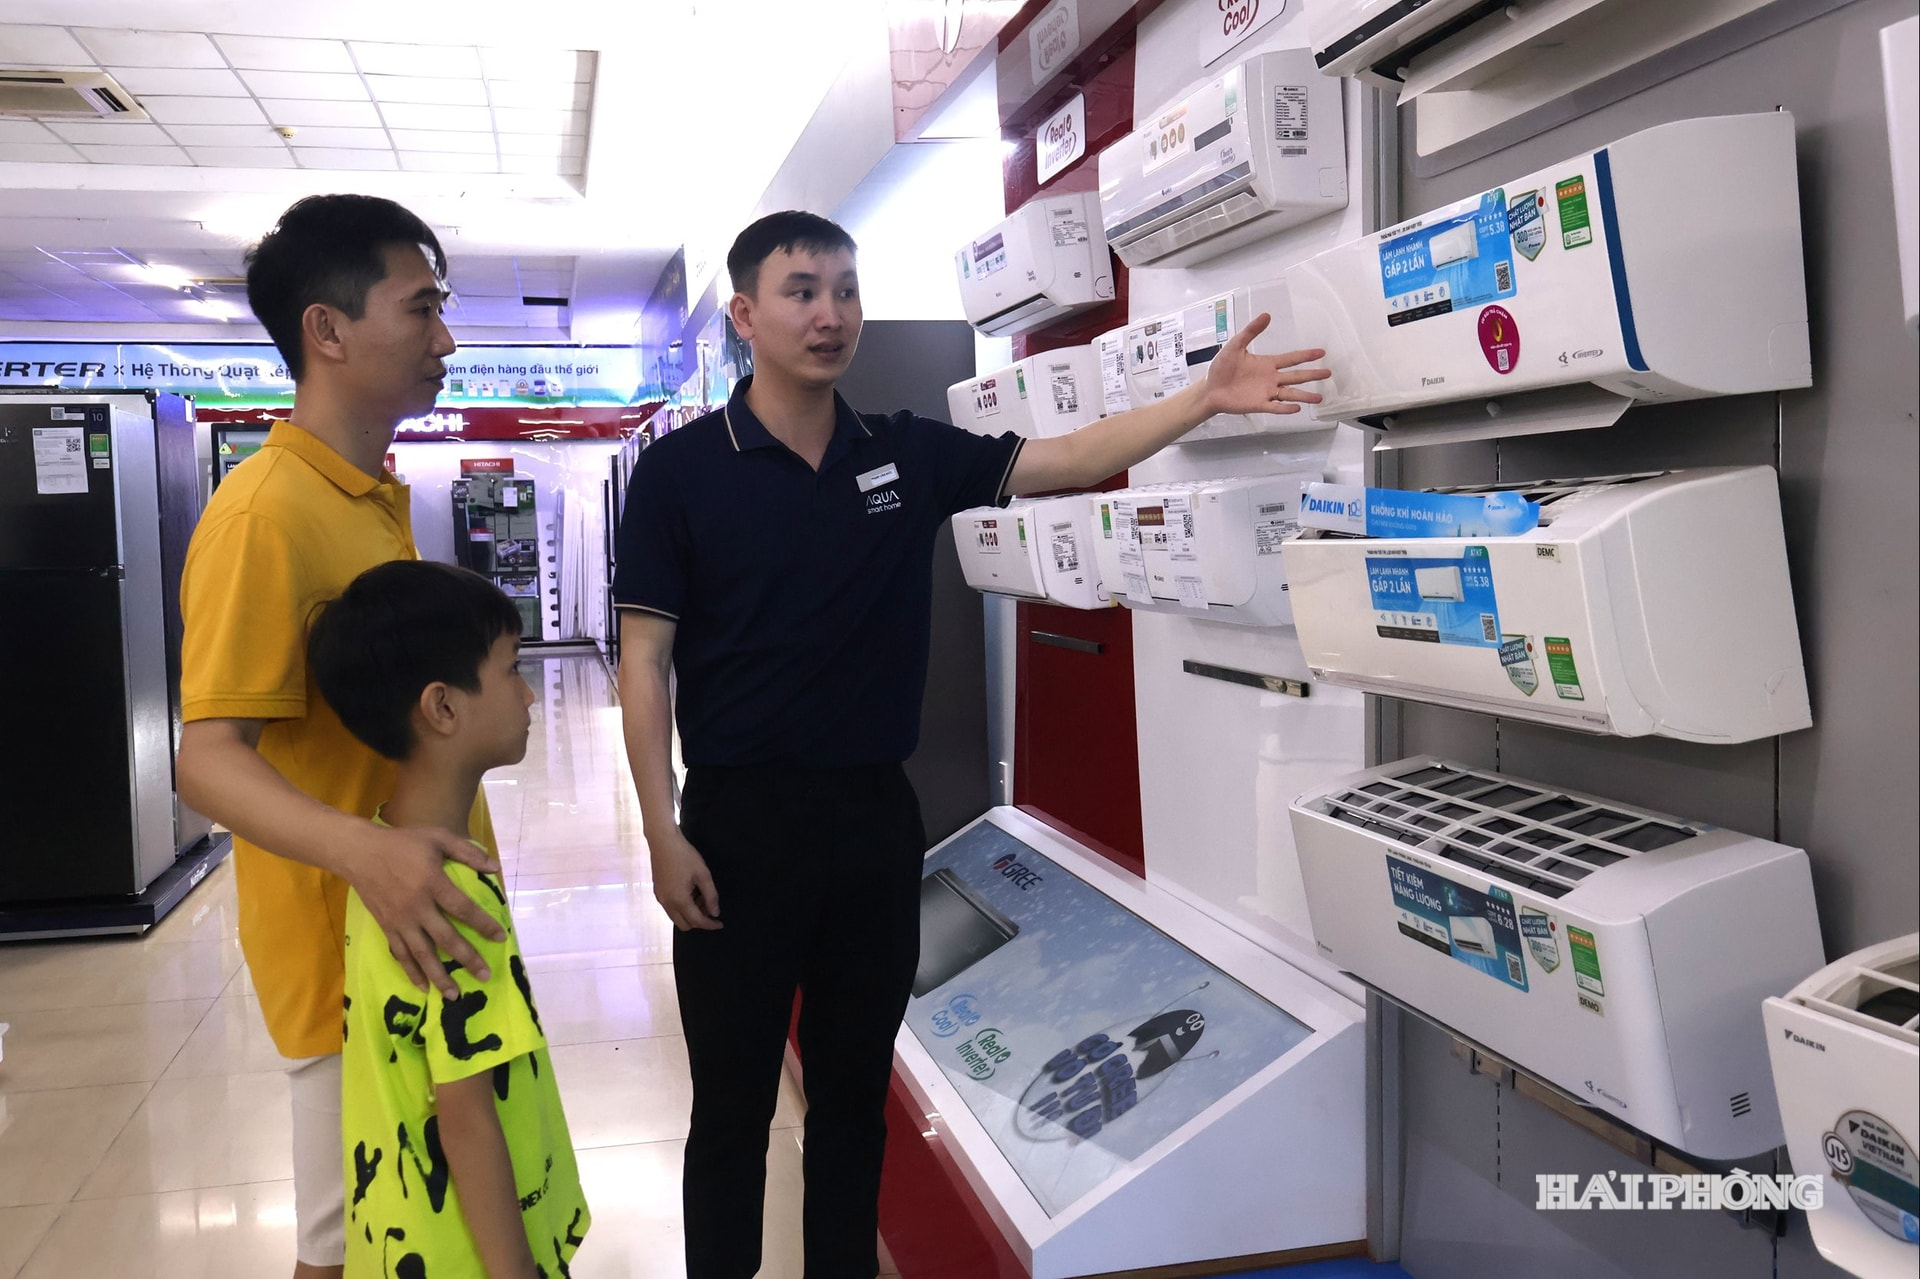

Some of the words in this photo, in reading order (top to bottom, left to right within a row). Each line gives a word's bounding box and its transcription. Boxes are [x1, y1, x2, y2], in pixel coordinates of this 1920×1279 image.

[1223, 0, 1250, 36] Cool
[1050, 117, 1066, 144] Real
[1045, 137, 1072, 169] Inverter
[1489, 220, 1505, 236] 5.38
[1402, 260, 1408, 273] 2
[0, 362, 106, 377] RTER
[132, 363, 153, 379] Hệ
[470, 364, 495, 377] điện
[498, 364, 527, 378] hàng
[555, 362, 573, 375] thế
[576, 363, 599, 378] giới
[1426, 377, 1445, 386] DAIKIN
[866, 490, 900, 507] AQUA
[1309, 498, 1345, 515] DAIKIN
[867, 505, 884, 515] smart
[883, 501, 902, 511] home
[1370, 501, 1396, 517] KHÔNG
[1396, 505, 1410, 519] KHÍ
[1411, 507, 1434, 522] HOÀN
[1389, 580, 1395, 593] 2
[1474, 576, 1490, 588] 5.38
[1001, 862, 1044, 891] GREE
[1390, 866, 1405, 881] TIẾT
[1579, 996, 1600, 1013] DEMO
[977, 1033, 1007, 1058] Real
[1793, 1035, 1826, 1052] DAIKIN
[955, 1039, 991, 1076] Inverter
[1860, 1128, 1905, 1156] DAIKIN
[1829, 1143, 1849, 1166] JIS
[1862, 1140, 1905, 1168] VIETNAM
